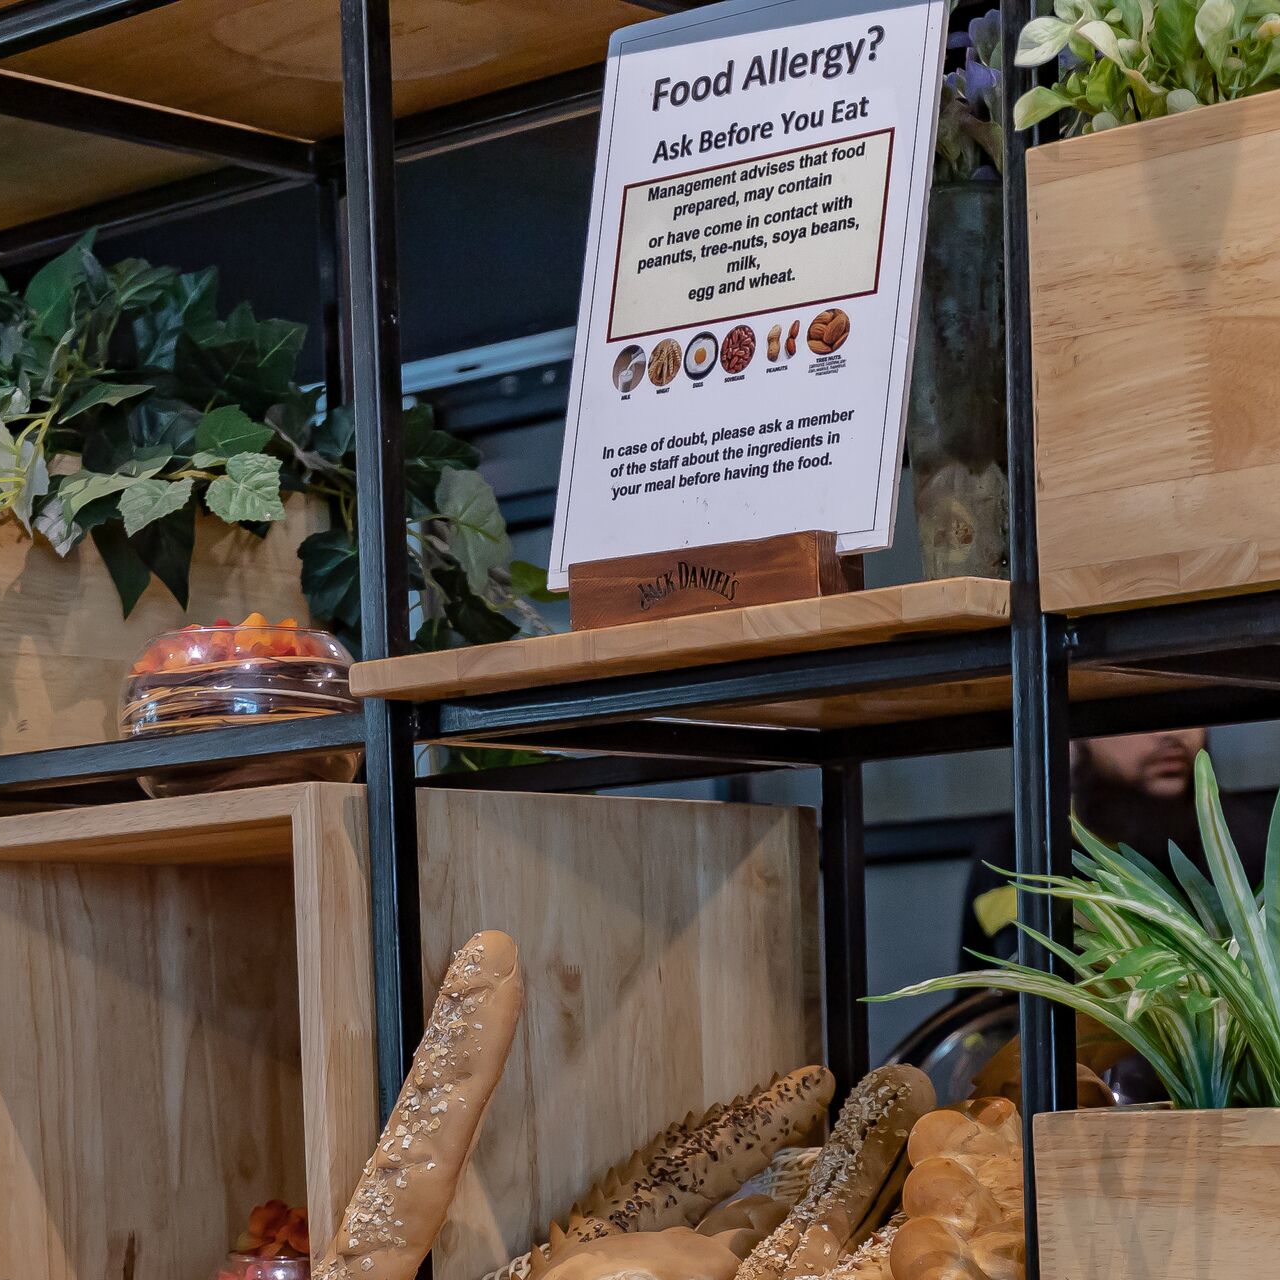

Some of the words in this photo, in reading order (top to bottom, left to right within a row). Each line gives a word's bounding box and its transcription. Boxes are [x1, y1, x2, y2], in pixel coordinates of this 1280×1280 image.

[652, 59, 735, 111] Food
[741, 25, 886, 91] Allergy?
[652, 134, 693, 164] Ask
[698, 121, 774, 154] Before
[781, 109, 824, 135] You
[831, 96, 870, 124] Eat
[647, 170, 737, 202] Management
[740, 158, 795, 183] advises
[799, 151, 828, 169] that
[831, 142, 866, 163] food
[673, 191, 740, 221] prepared,
[744, 185, 775, 203] may
[777, 172, 833, 196] contain
[637, 250, 697, 274] peanuts,
[700, 235, 768, 258] tree-nuts,
[772, 225, 808, 244] soya
[810, 215, 860, 236] beans,
[648, 235, 665, 249] or
[667, 228, 700, 246] have
[703, 219, 742, 238] come
[746, 214, 760, 229] in
[763, 204, 818, 225] contact
[821, 195, 853, 213] with
[688, 284, 715, 302] egg
[718, 277, 746, 295] and
[749, 268, 796, 288] wheat.
[726, 254, 761, 273] milk,
[602, 447, 615, 460] In
[617, 443, 648, 457] case
[650, 437, 666, 452] of
[667, 431, 709, 449] doubt,
[711, 426, 755, 445] please
[758, 419, 783, 434] ask
[785, 419, 794, 431] a
[797, 408, 855, 429] member
[610, 463, 626, 478] of
[626, 459, 646, 476] the
[649, 455, 681, 472] staff
[681, 449, 720, 467] about
[722, 445, 744, 461] the
[747, 435, 823, 457] ingredients
[827, 431, 841, 445] in
[611, 484, 642, 501] your
[644, 477, 675, 493] meal
[679, 470, 721, 488] before
[723, 463, 769, 481] having
[772, 457, 795, 474] the
[797, 452, 833, 470] food.
[638, 570, 675, 611] JACK
[678, 562, 740, 601] DANIEL'S
